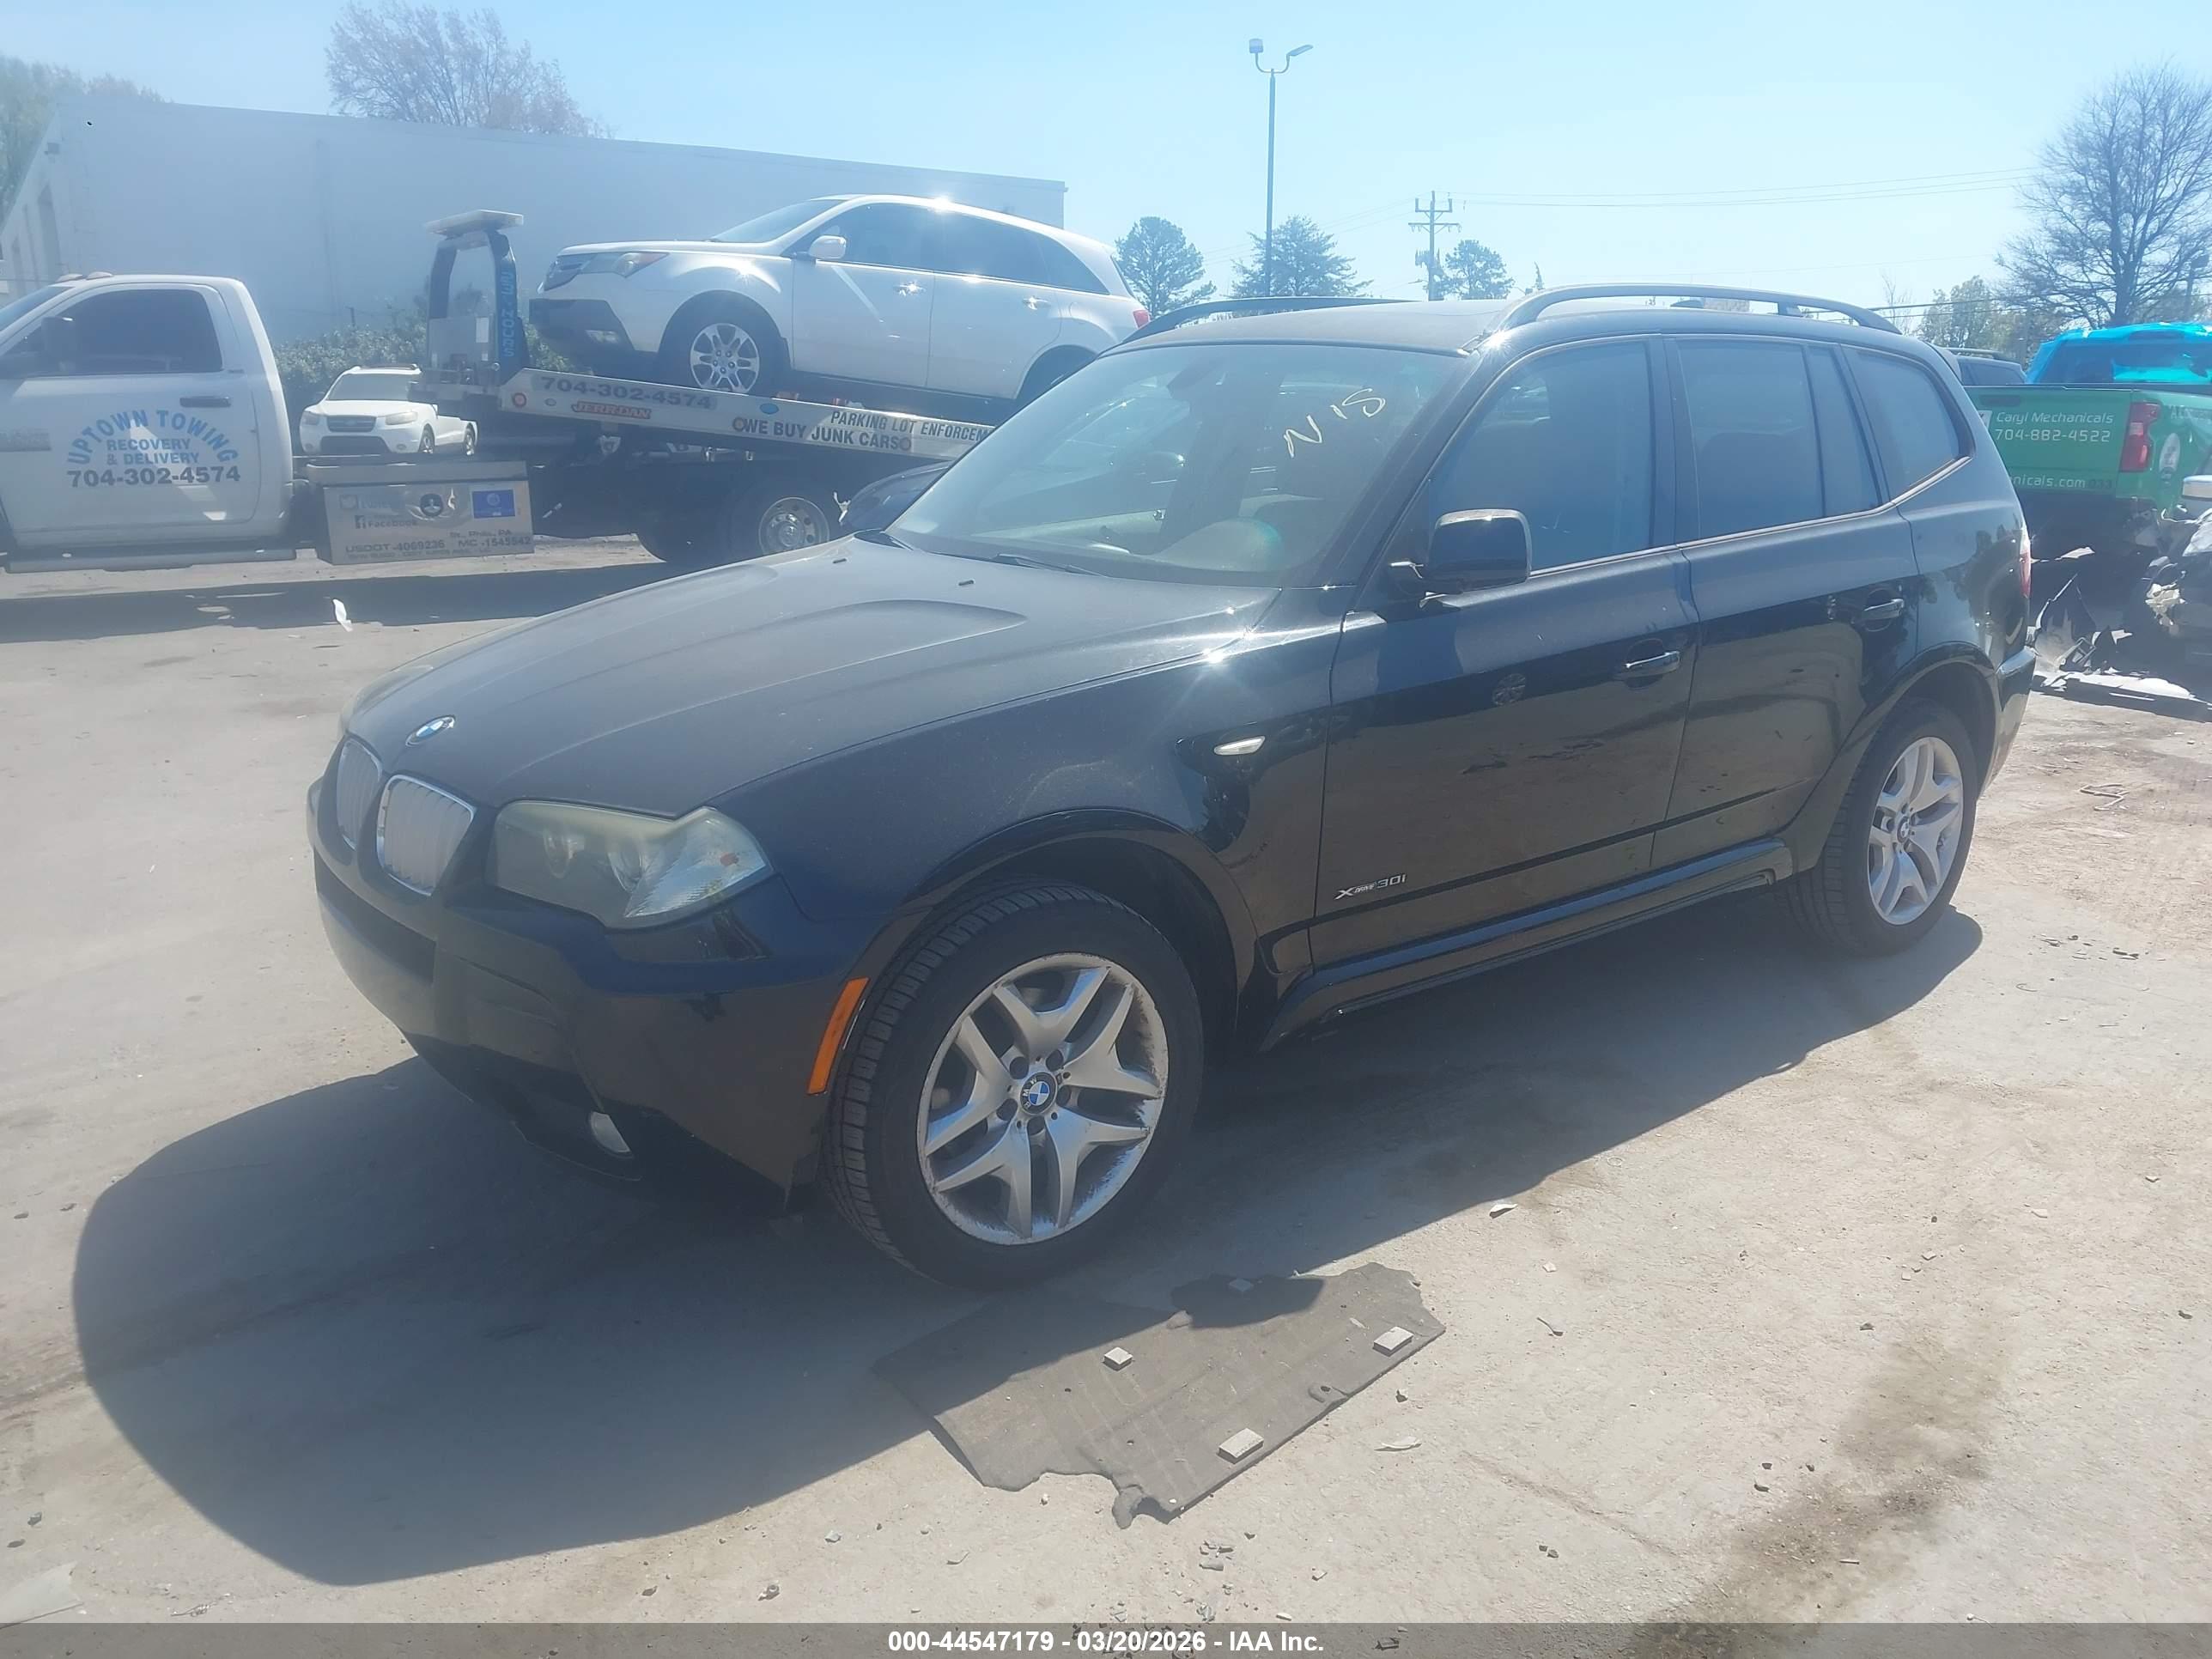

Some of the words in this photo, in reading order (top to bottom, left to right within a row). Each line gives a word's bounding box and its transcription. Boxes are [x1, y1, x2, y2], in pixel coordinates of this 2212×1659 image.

[540, 376, 713, 410] 704-302-4574
[830, 410, 888, 430] PARKING
[893, 417, 916, 434] LOT
[1996, 412, 2028, 424] Caryl
[2032, 412, 2114, 424] Mechanicals
[68, 410, 149, 465] UPTOWN
[155, 410, 239, 463] TOWING
[744, 419, 769, 434] WE
[774, 422, 806, 439] BUY
[811, 427, 854, 445] JUNK
[860, 431, 900, 451] CARS
[1995, 428, 2111, 442] 704-882-4522
[106, 439, 191, 451] RECOVERY
[106, 453, 118, 465] &
[124, 452, 199, 465] DELIVERY
[67, 465, 240, 488] 704-302-4574
[2012, 474, 2086, 488] nicals.com
